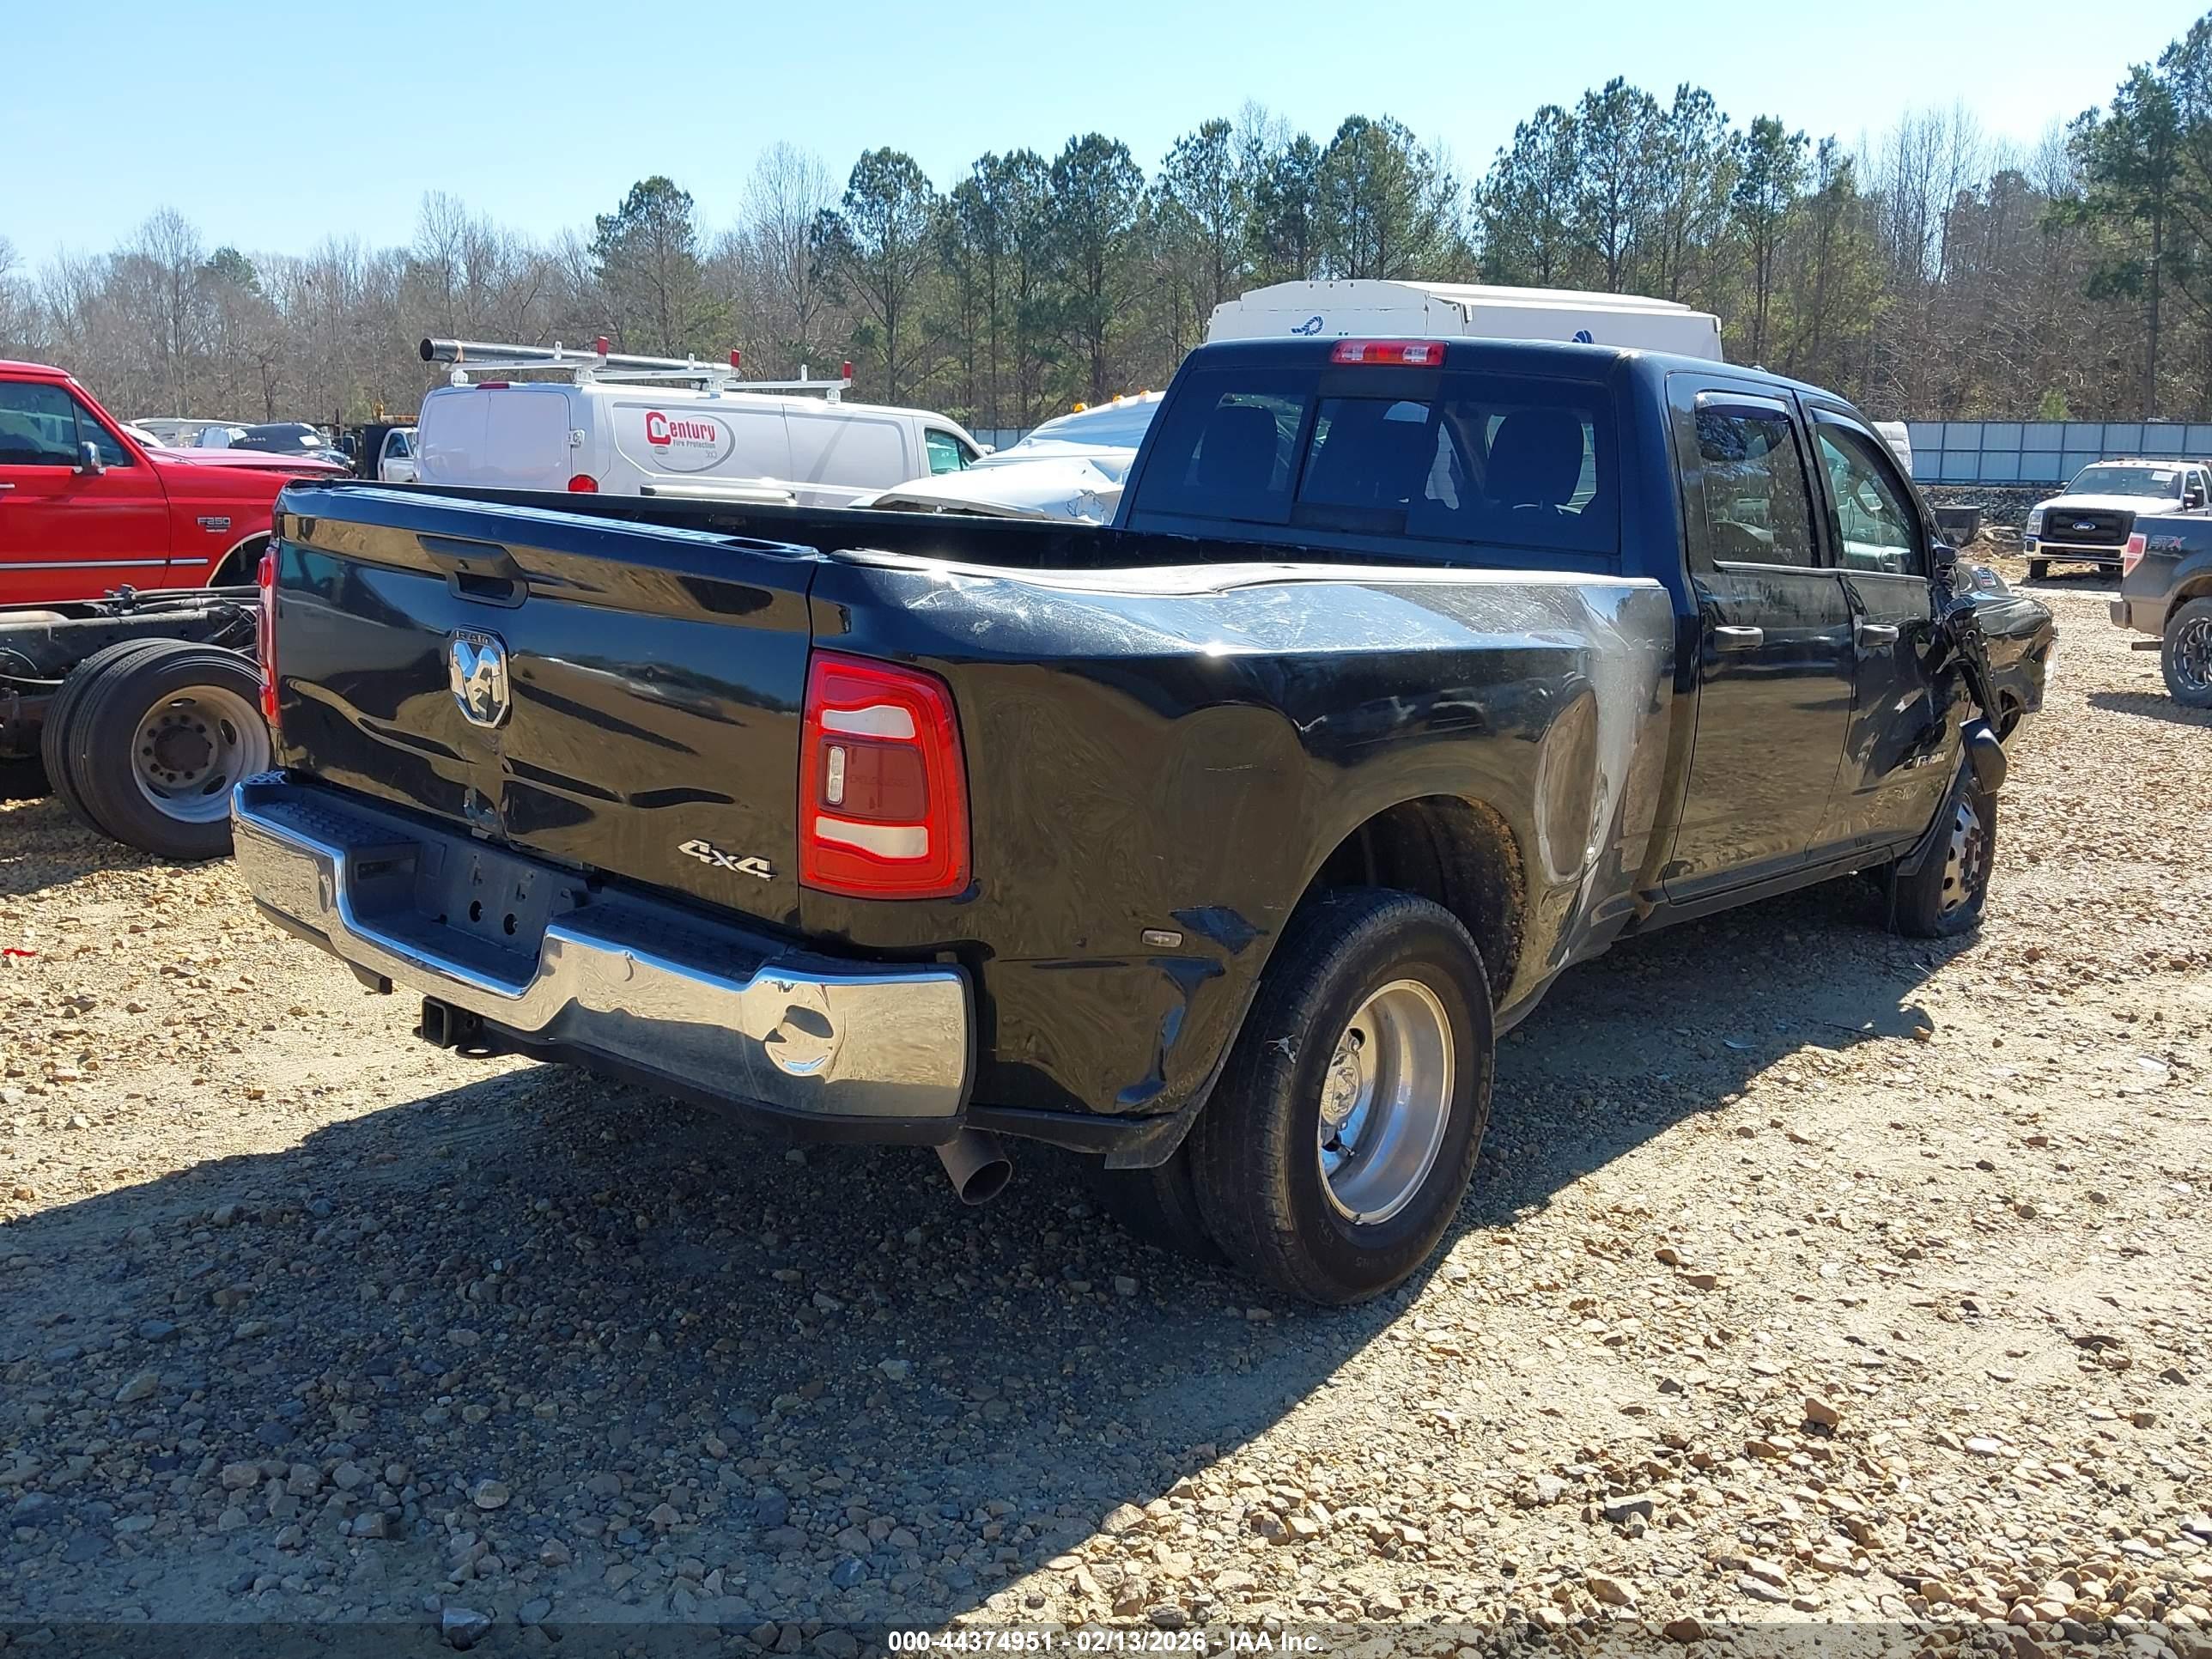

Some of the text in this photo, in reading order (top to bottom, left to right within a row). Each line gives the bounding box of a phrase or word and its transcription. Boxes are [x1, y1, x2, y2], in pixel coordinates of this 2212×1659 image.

[646, 412, 716, 445] Century
[686, 441, 716, 449] Protection
[2148, 535, 2186, 550] STX
